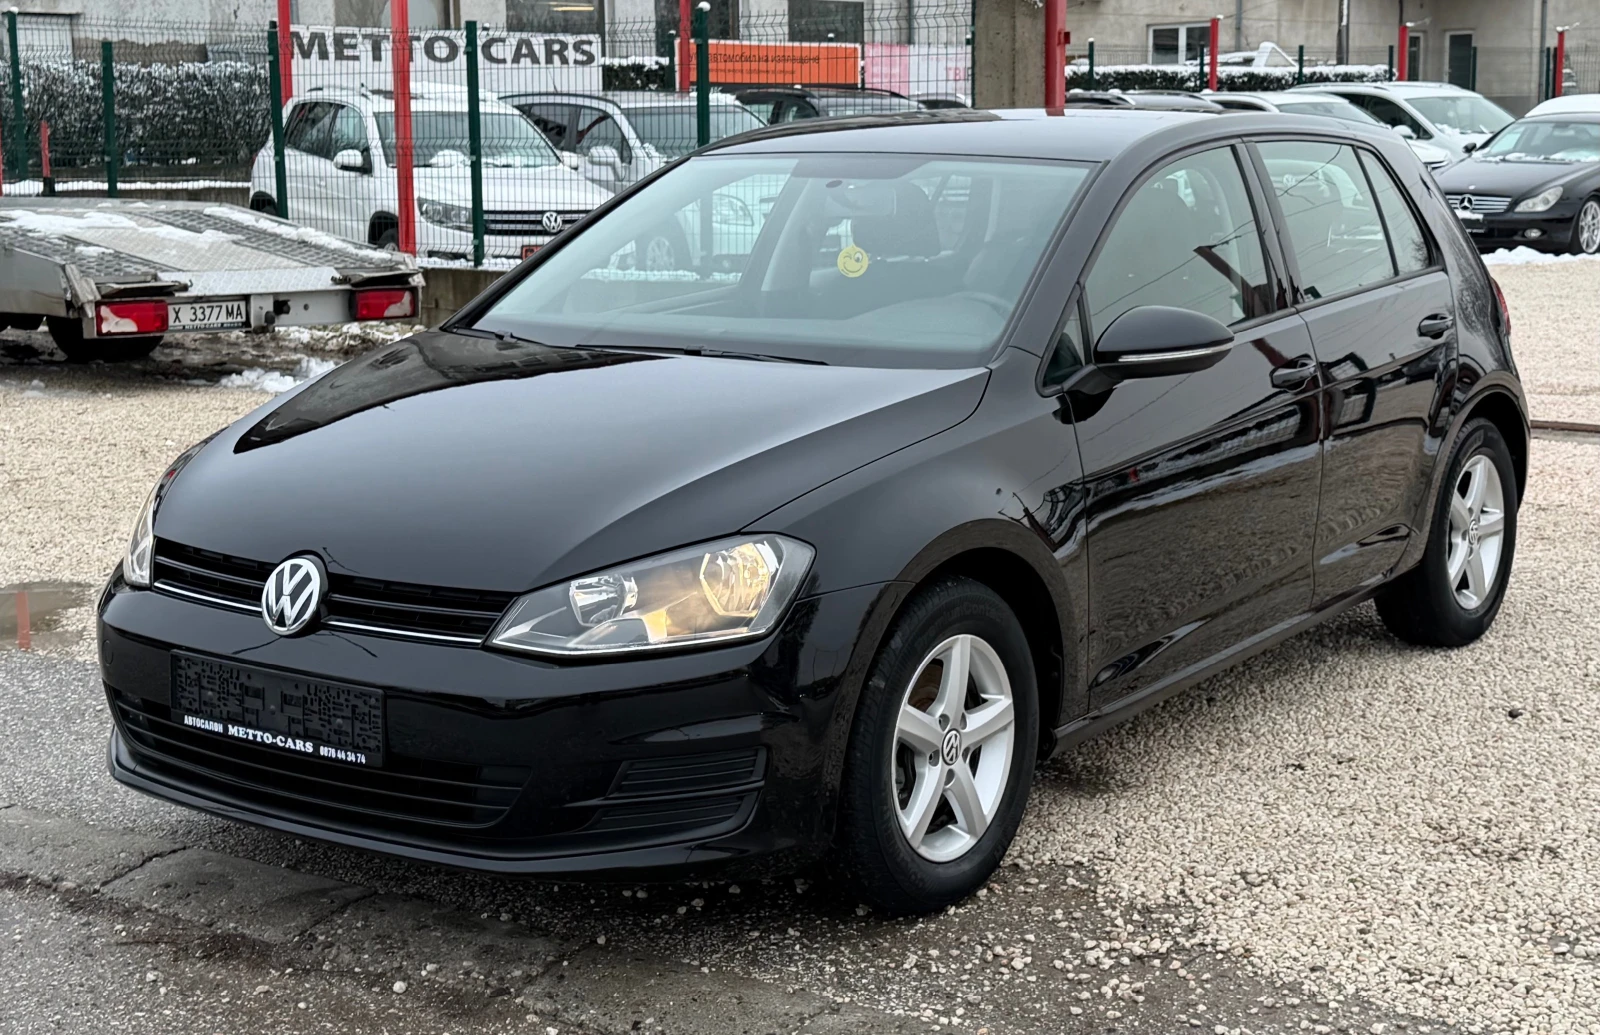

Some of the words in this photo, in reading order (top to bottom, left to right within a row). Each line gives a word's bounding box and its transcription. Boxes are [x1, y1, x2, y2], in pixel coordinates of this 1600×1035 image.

[481, 36, 596, 66] CARS
[173, 307, 182, 324] X
[189, 305, 223, 322] 3377
[226, 303, 243, 320] MA
[183, 714, 224, 733] АВТОСАЛОН
[227, 724, 314, 753] METTO-CARS
[356, 753, 366, 765] 74
